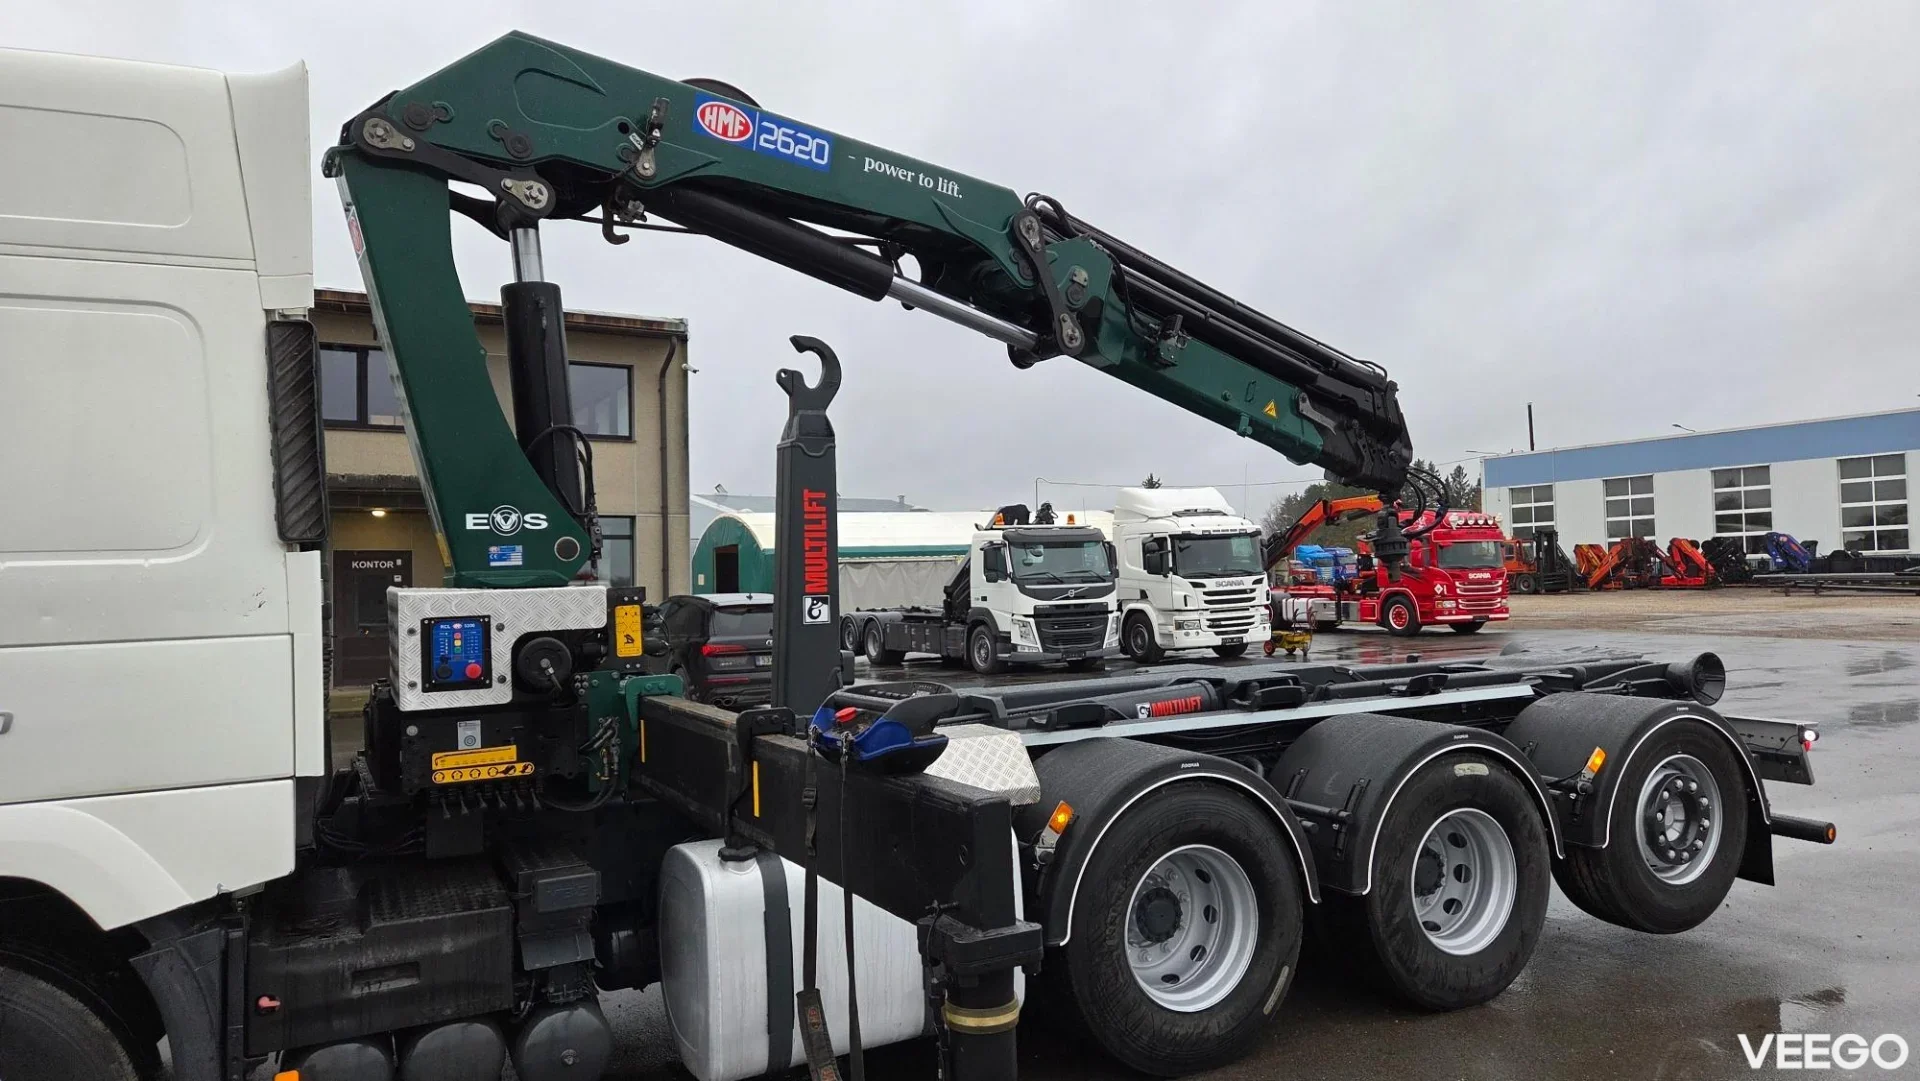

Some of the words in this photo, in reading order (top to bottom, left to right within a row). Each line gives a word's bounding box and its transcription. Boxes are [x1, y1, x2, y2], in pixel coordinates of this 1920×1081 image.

[704, 106, 746, 138] HMF
[759, 122, 829, 165] 2620
[864, 156, 914, 183] power
[918, 172, 934, 188] to
[936, 177, 964, 198] lift.
[804, 489, 828, 593] MULTILIFT
[351, 561, 394, 569] KONTOR
[1215, 580, 1244, 588] SCANIA
[1152, 697, 1202, 717] MULTILIFT
